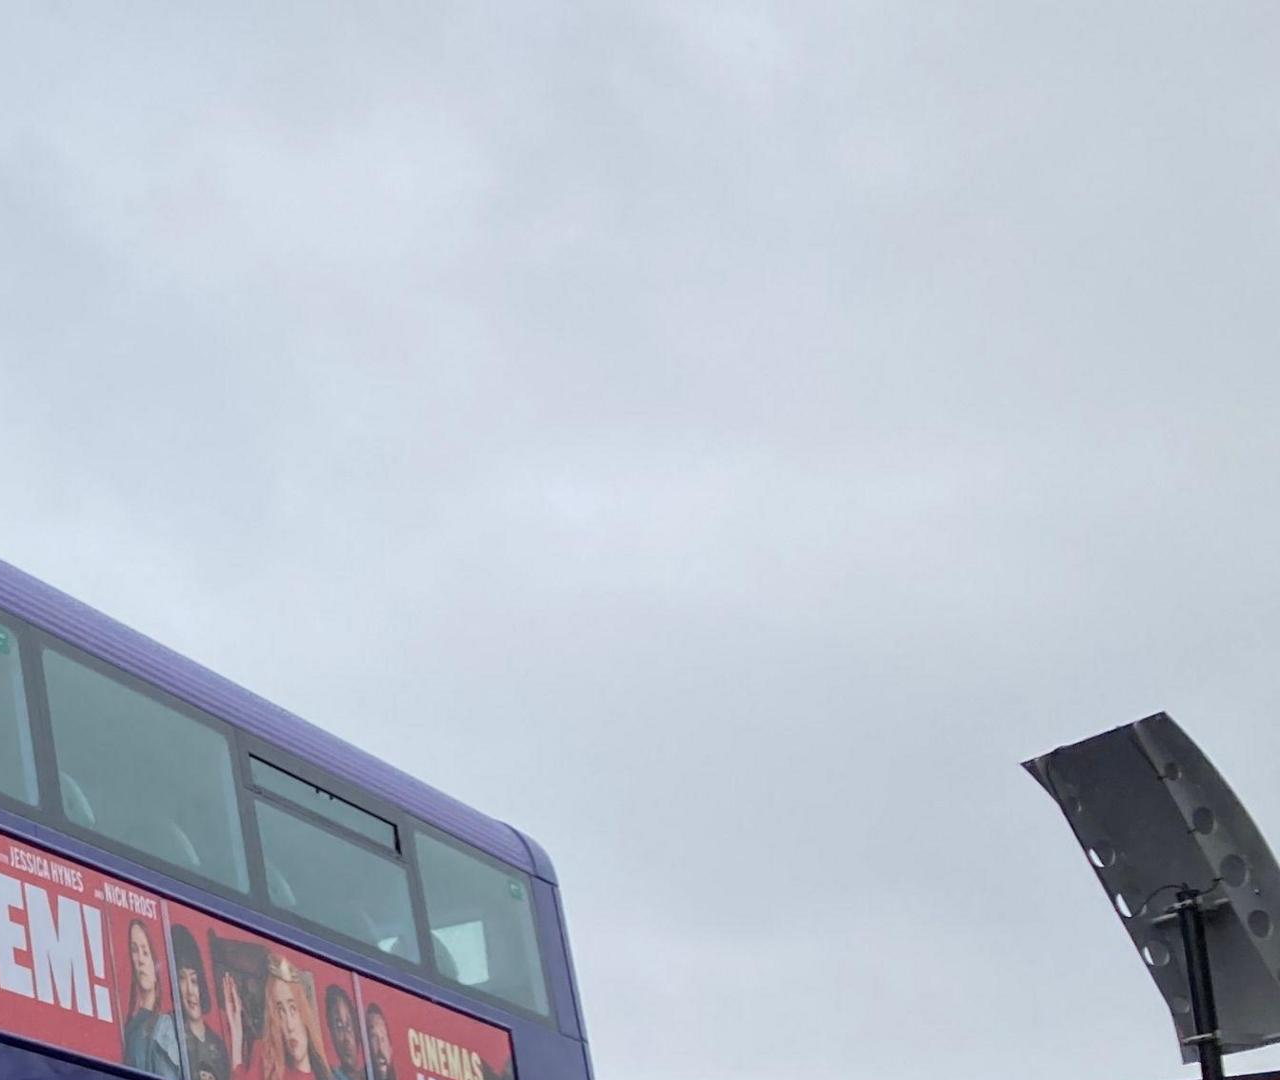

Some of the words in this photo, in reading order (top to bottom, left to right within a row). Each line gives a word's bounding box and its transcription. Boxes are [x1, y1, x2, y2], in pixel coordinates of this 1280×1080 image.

[10, 845, 51, 880] JESSICA
[50, 861, 84, 893] HYNES
[103, 882, 129, 910] NICK
[128, 891, 157, 920] FROST
